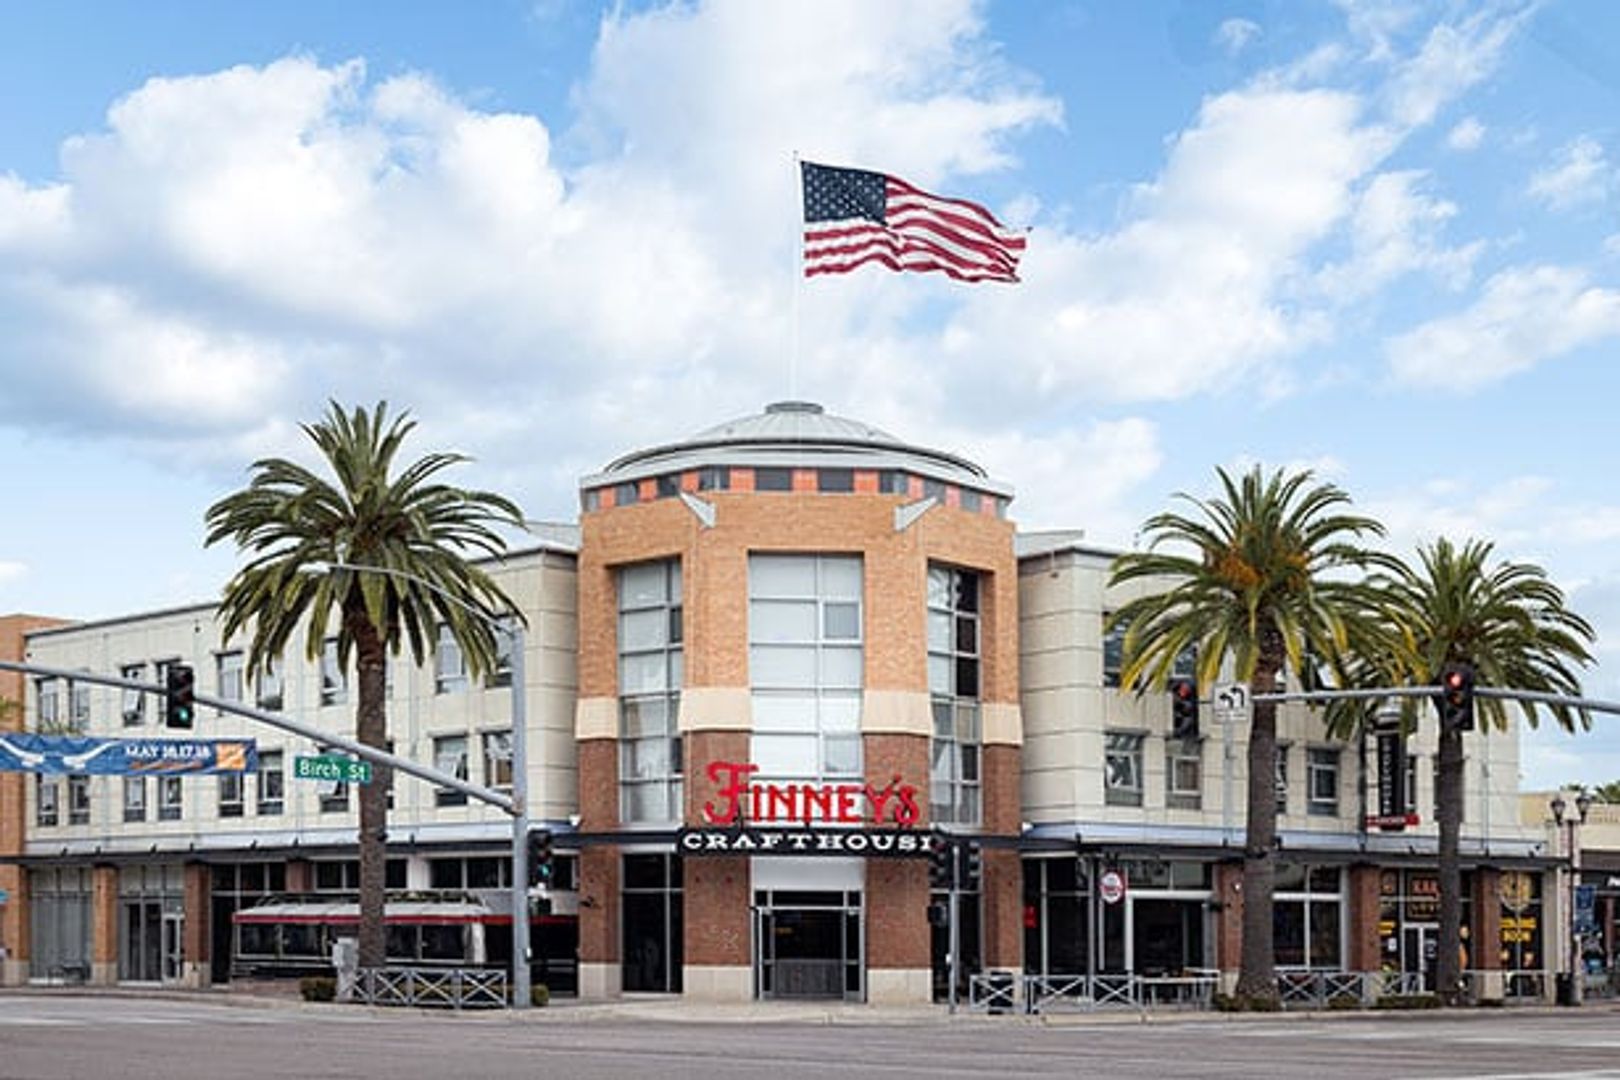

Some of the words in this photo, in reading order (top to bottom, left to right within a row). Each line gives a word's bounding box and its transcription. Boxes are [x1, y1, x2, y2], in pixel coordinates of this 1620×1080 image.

[300, 759, 341, 779] Birch
[347, 763, 365, 781] St
[703, 761, 920, 825] FINNEY'S
